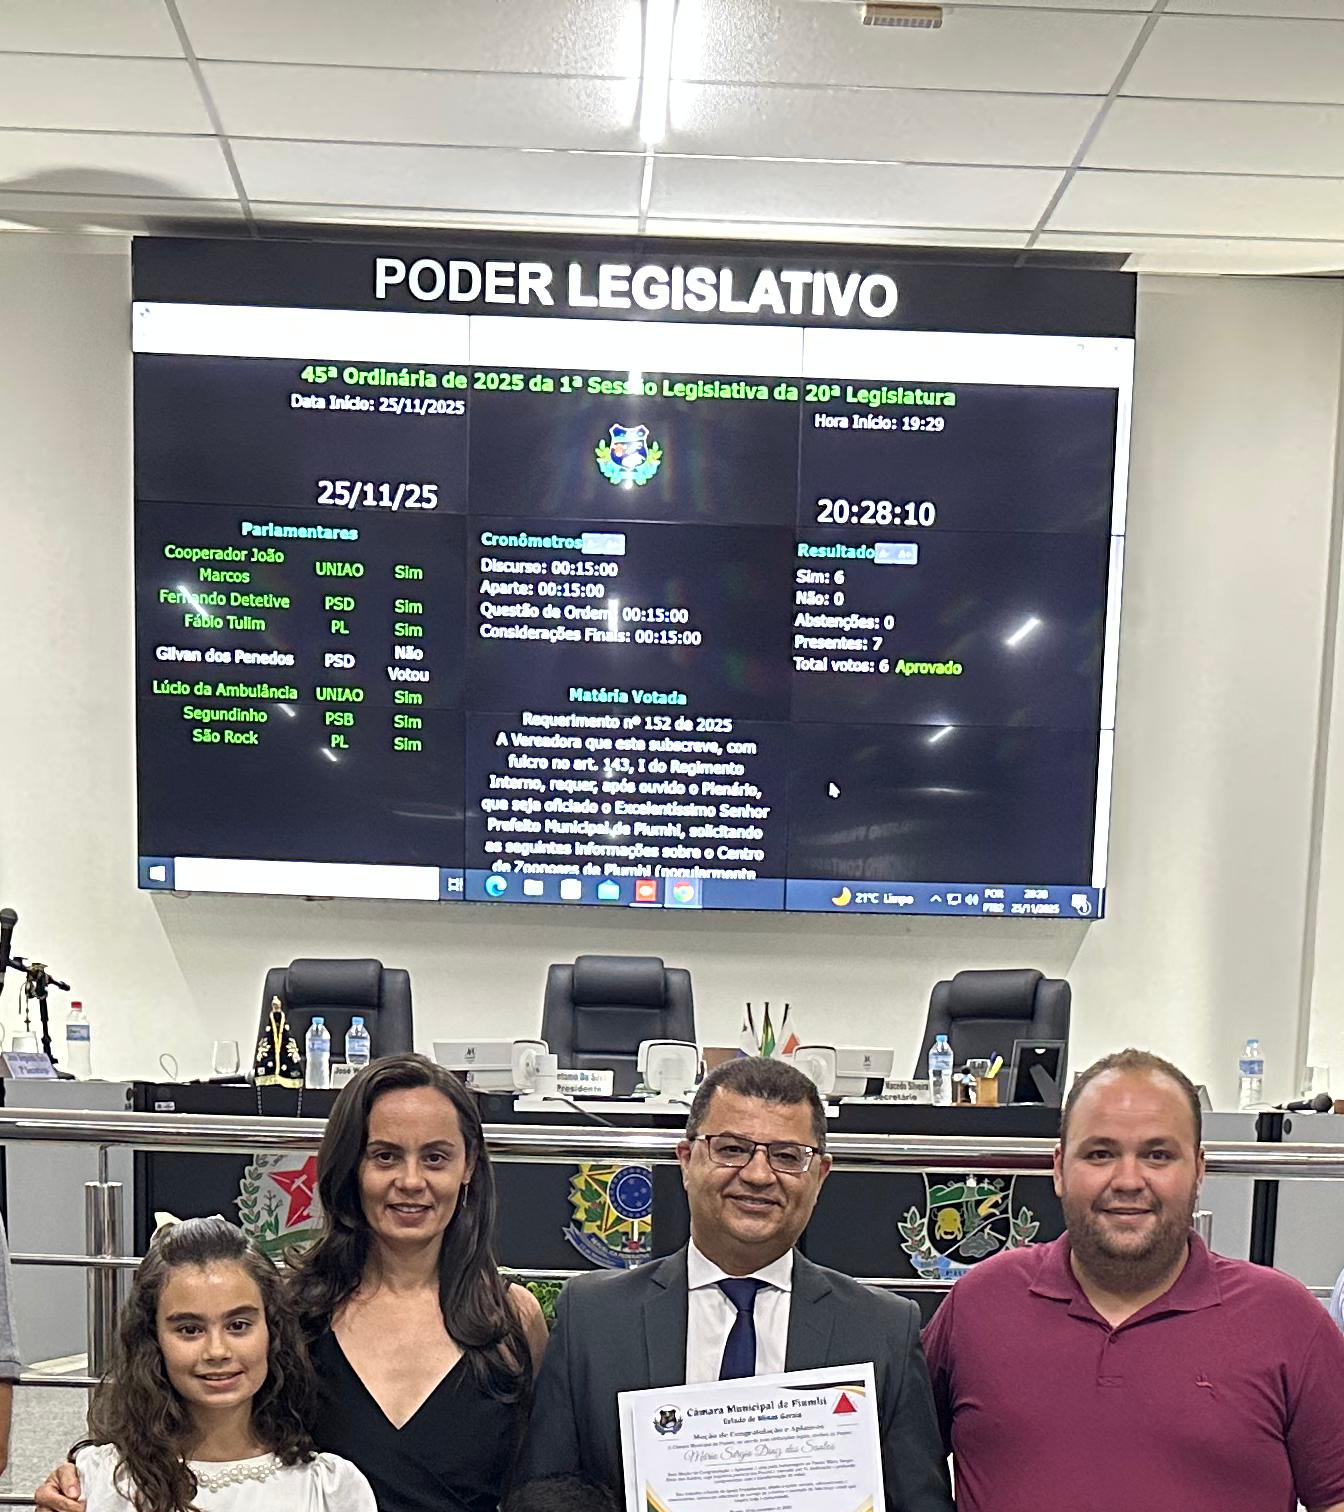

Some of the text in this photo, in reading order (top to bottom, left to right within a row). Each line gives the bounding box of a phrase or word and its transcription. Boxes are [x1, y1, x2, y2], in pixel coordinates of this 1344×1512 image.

[375, 257, 898, 318] PODER LEGISLATIVO
[301, 365, 956, 408] 45ª Ordinária de 2025 da 1ª Sesso Legislativa da 20ª Legislatura
[291, 393, 465, 415] Data Início: 25/11/2025
[815, 413, 945, 432] Hora Início: 19:29
[317, 480, 439, 510] 25/11/25
[816, 498, 936, 526] 20:28:10
[241, 522, 359, 541] Parlamentares
[481, 532, 584, 550] Cronômetros
[164, 544, 285, 563] Cooperador João
[797, 543, 875, 559] Resultado
[315, 561, 364, 577] UNIAO
[394, 565, 423, 580] Sim
[480, 558, 619, 577] Discurso: 00:15:00
[199, 568, 250, 584] Marcos
[796, 569, 845, 585] Sim: 6
[480, 581, 605, 598] Aparte: 00:15:00
[159, 589, 290, 609] Fernando Detetive
[324, 596, 355, 612] PSD
[795, 590, 845, 606] Não: 0
[394, 599, 423, 614] Sim
[480, 602, 689, 623] Questão de Ordem 00:15:00
[184, 613, 266, 631] Fábio Tulim
[331, 620, 349, 634] PL
[794, 612, 895, 630] Abstenções: 0
[394, 623, 423, 638] Sim
[480, 624, 581, 643] Considerações
[634, 629, 702, 645] 00:15:00
[794, 634, 883, 650] Presentes: 7
[156, 646, 295, 667] Gilvan dos Penedos
[324, 653, 355, 668] PSD
[394, 645, 423, 661] Não
[387, 666, 430, 682] Votou
[793, 656, 963, 677] Total votos: 6 Aprovado
[153, 679, 298, 700] Lúcio da Ambulância
[315, 687, 364, 702] UNIAO
[394, 690, 423, 705] Sim
[569, 686, 687, 707] Matéria Votada
[183, 706, 268, 723] Segundinho
[325, 712, 354, 726] PSB
[394, 714, 422, 729] Sim
[522, 711, 621, 729] Requerimento
[645, 716, 672, 731] 152
[696, 717, 733, 733] 2025
[192, 729, 258, 745] São Rock
[331, 735, 349, 749] PL
[394, 737, 422, 751] Sim
[496, 731, 509, 747] A
[551, 758, 571, 770] no
[648, 758, 668, 774] do
[688, 783, 699, 796] o
[601, 802, 612, 814] o
[727, 1401, 774, 1414] Municipal
